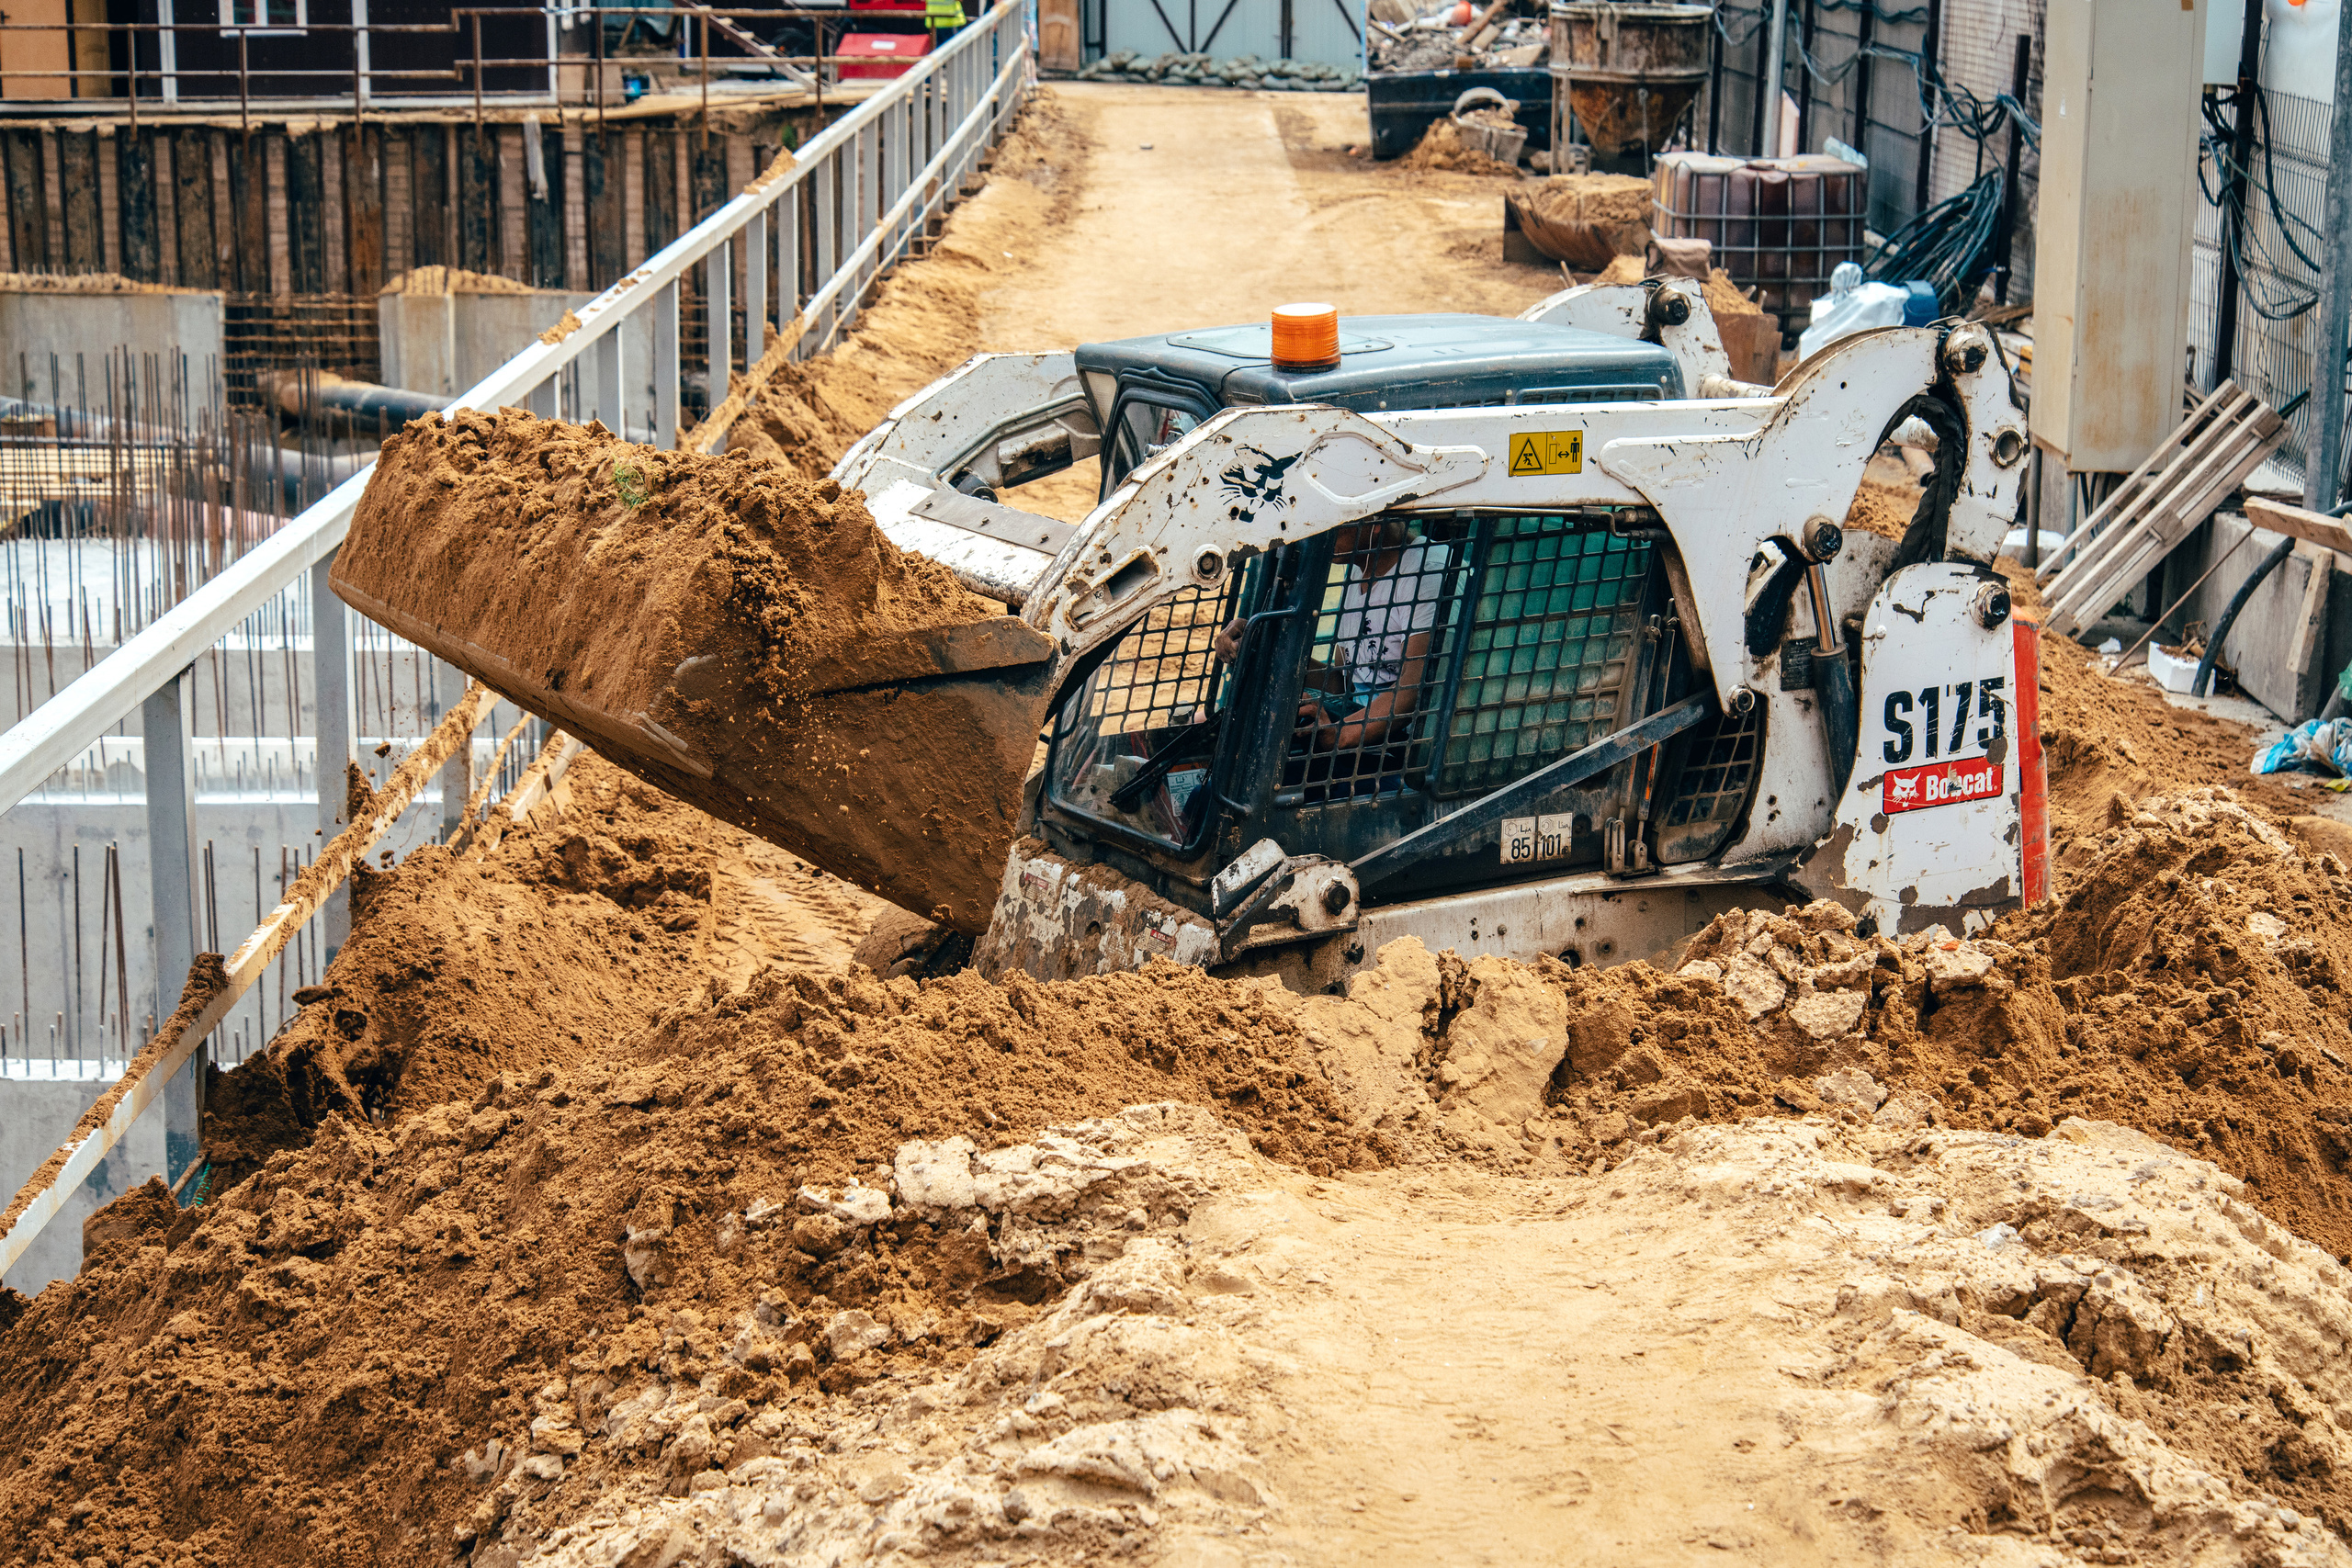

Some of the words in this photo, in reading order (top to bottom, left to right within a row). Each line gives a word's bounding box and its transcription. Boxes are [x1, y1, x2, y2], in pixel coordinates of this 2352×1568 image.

[1883, 676, 2006, 764] S175
[1511, 836, 1531, 860] 85
[1540, 833, 1562, 860] 101
